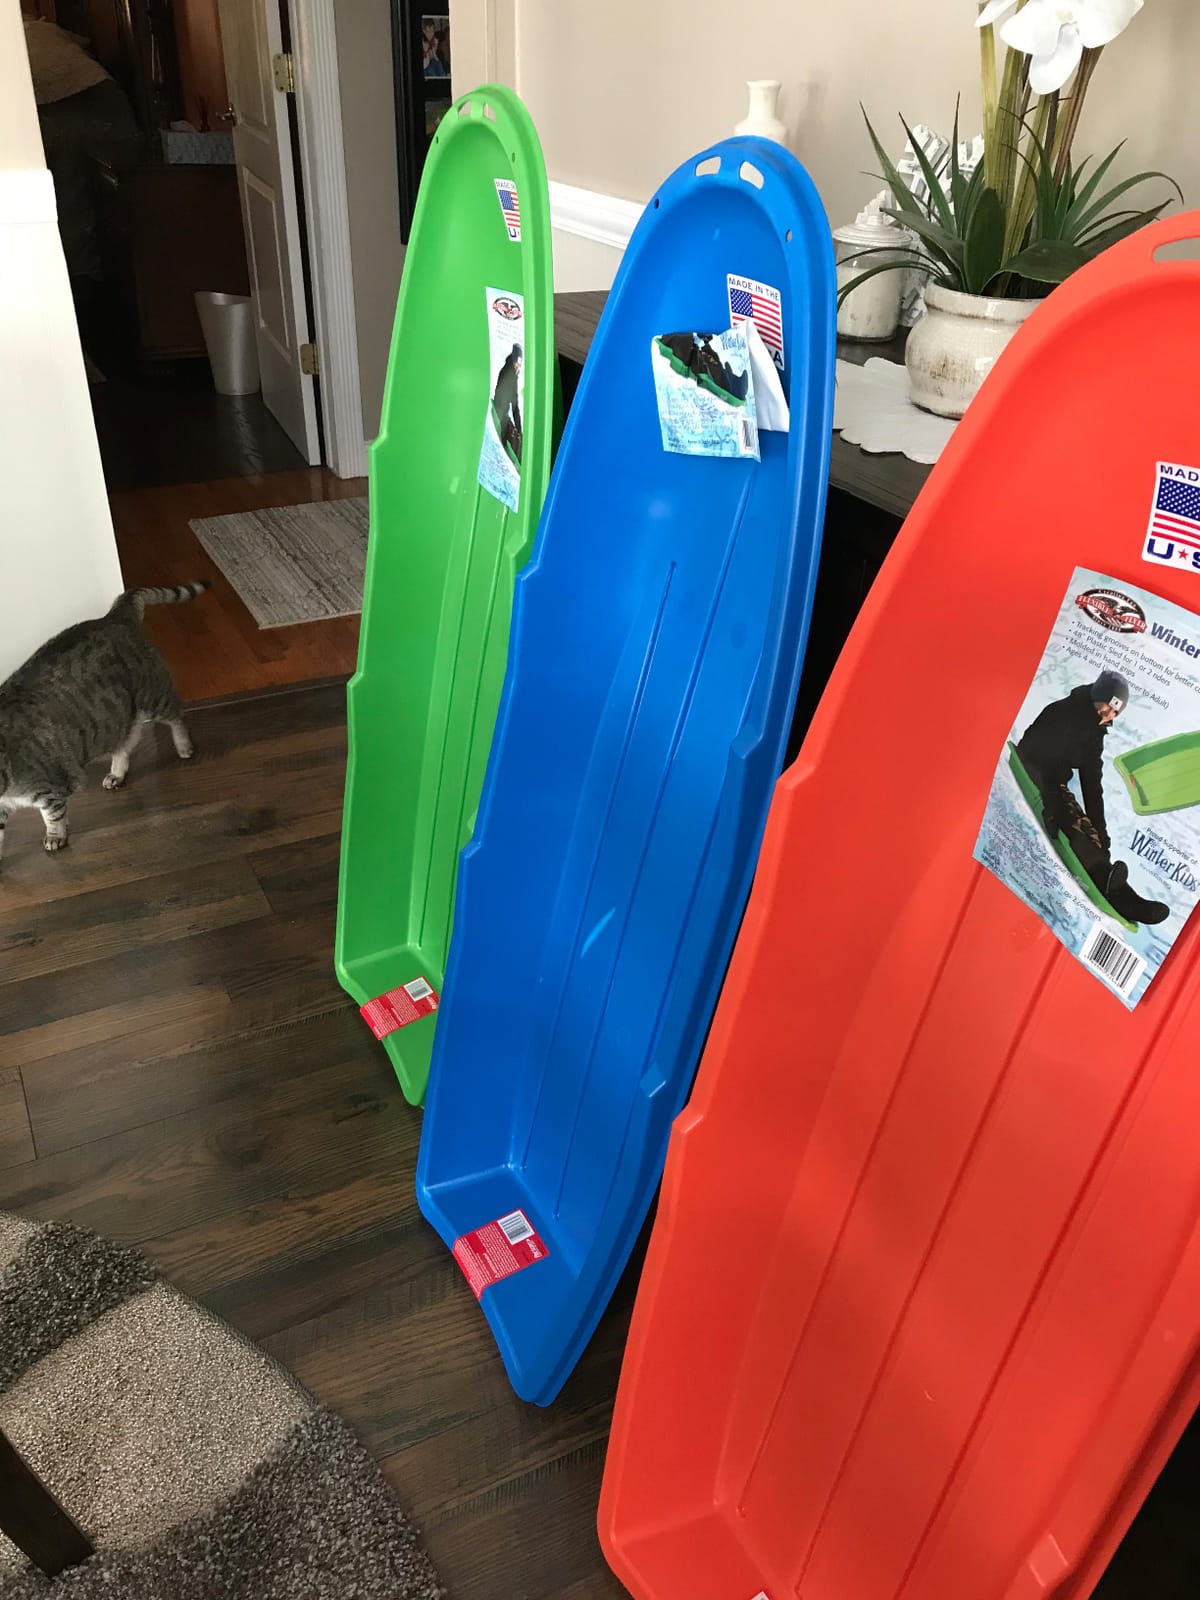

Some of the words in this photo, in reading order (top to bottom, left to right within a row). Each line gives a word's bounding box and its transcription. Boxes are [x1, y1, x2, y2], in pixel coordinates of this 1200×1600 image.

[728, 277, 753, 291] MADE
[755, 285, 763, 294] IN
[765, 288, 780, 301] THE
[1160, 464, 1200, 482] MAD
[1124, 615, 1146, 630] FLYER
[1151, 622, 1200, 659] Winter
[1070, 637, 1096, 655] Molded
[1103, 653, 1121, 668] hand
[1119, 665, 1136, 677] grips
[1077, 621, 1104, 640] Tracking
[1103, 636, 1130, 652] grooves
[1130, 649, 1140, 657] on
[1141, 653, 1164, 671] bottom
[1164, 666, 1174, 676] for
[1174, 672, 1194, 688] better
[1087, 635, 1108, 651] Plastic
[1108, 646, 1123, 659] Sled
[1122, 654, 1132, 664] for
[1138, 664, 1146, 672] or
[1146, 668, 1153, 676] 2
[1152, 672, 1171, 687] riders
[1066, 646, 1082, 659] Ages
[1088, 659, 1102, 669] and
[1142, 688, 1150, 697] to
[1150, 693, 1170, 710] Adult)
[1163, 839, 1190, 860] Supporter
